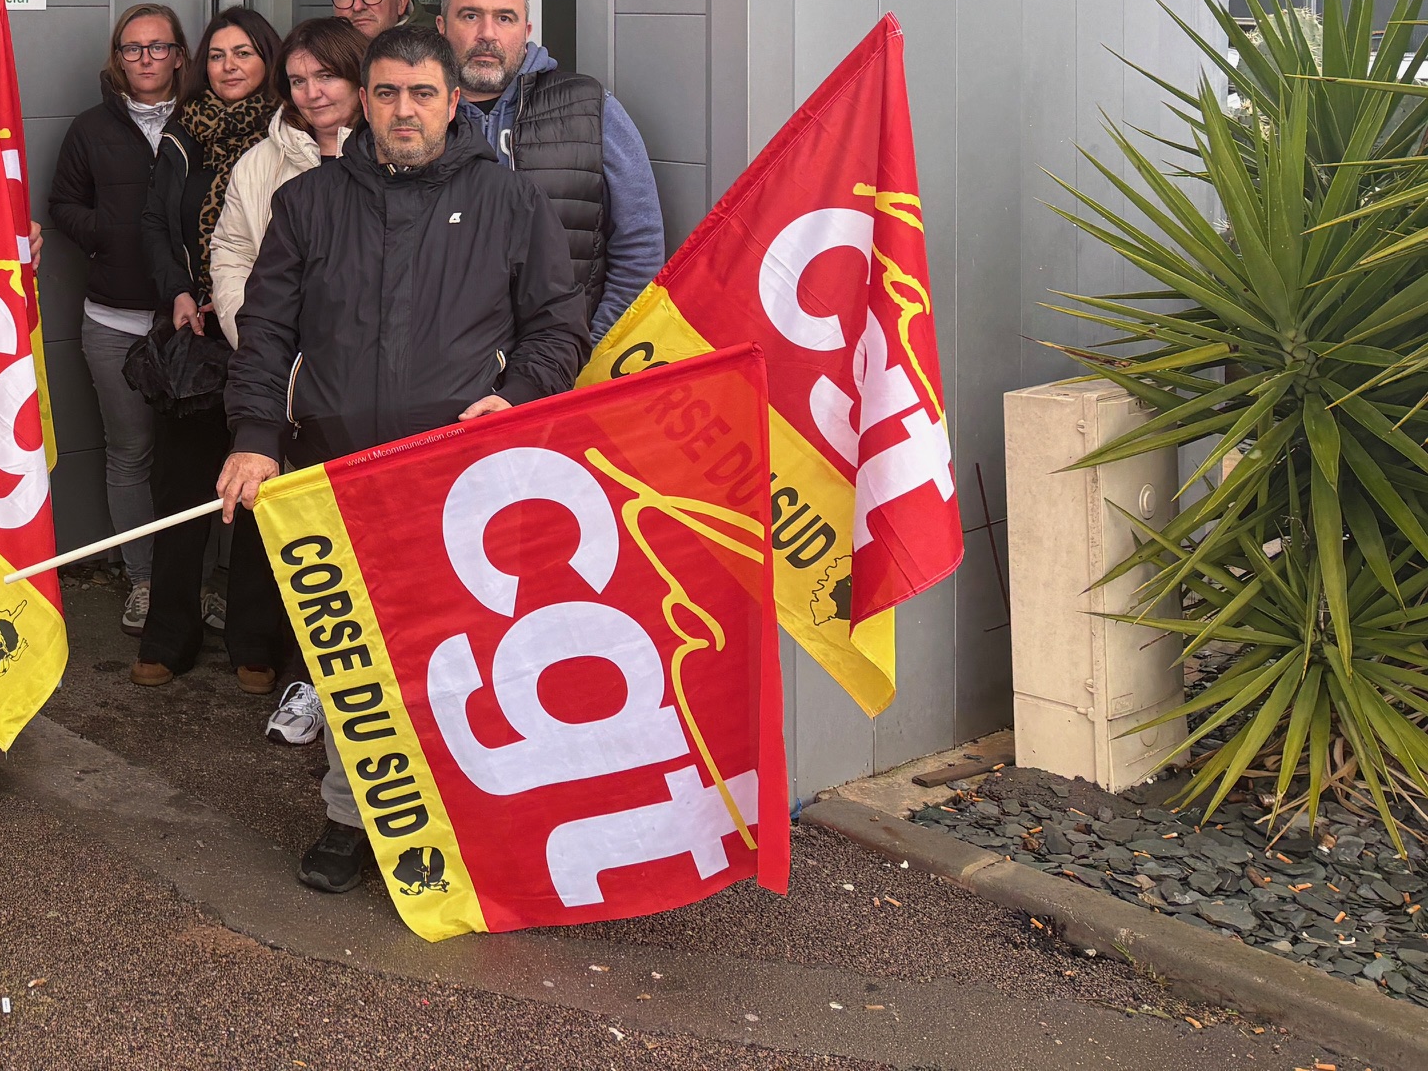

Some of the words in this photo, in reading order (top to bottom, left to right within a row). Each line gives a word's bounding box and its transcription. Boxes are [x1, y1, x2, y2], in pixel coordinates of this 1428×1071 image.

[346, 426, 466, 467] www.LMcommunication.com
[610, 341, 732, 464] CRSE
[754, 486, 837, 569] SUD
[279, 534, 372, 677] CORSE
[330, 682, 397, 743] DU
[426, 446, 759, 909] cgt
[355, 751, 430, 839] SUD
